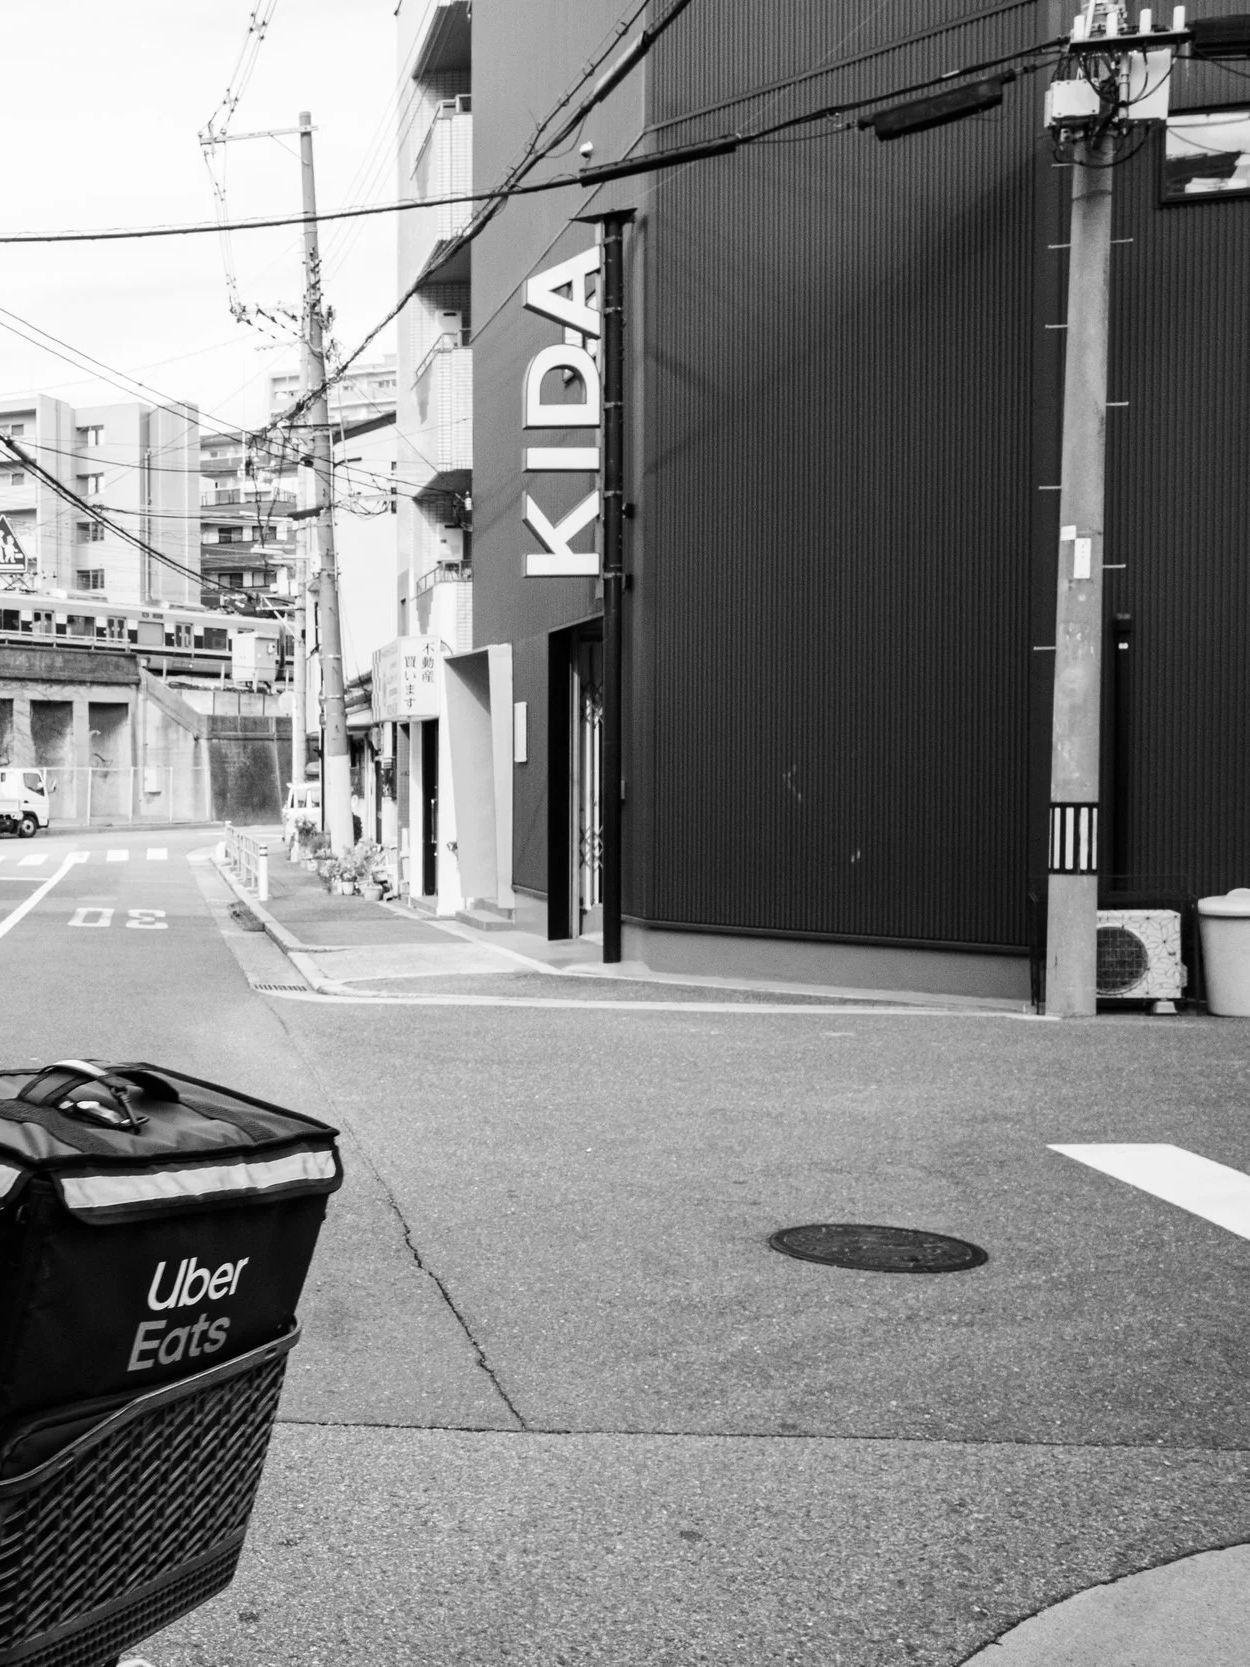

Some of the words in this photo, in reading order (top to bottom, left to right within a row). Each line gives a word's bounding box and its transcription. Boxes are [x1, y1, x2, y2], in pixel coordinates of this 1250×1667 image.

[525, 245, 601, 576] KIDA
[404, 656, 417, 709] 買います
[421, 643, 435, 683] 不動産
[147, 1256, 250, 1311] Uber
[126, 1313, 231, 1372] Eats
